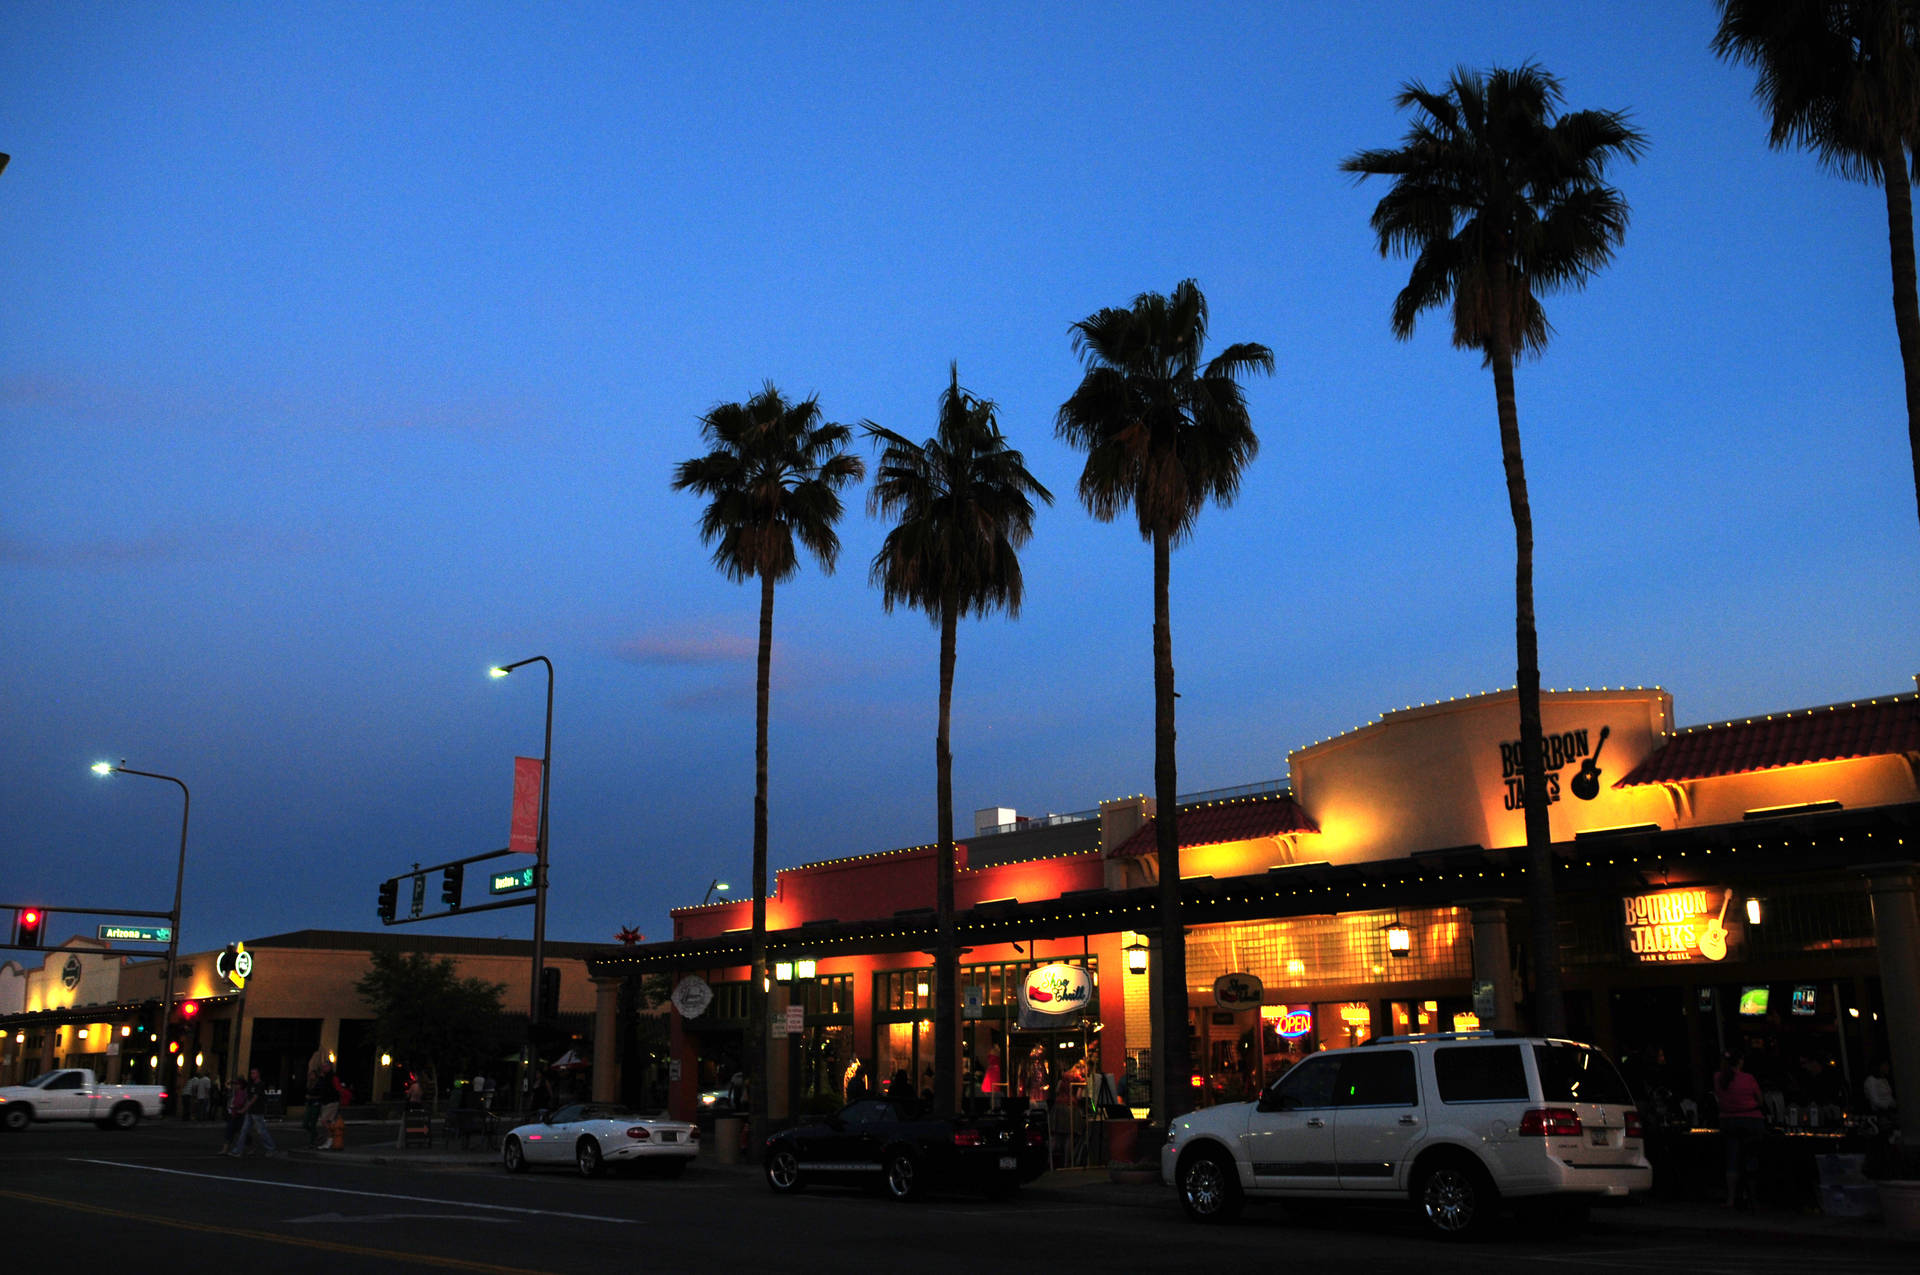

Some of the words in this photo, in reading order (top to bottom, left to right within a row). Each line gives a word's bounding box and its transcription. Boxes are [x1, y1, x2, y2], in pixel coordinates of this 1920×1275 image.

[1500, 729, 1588, 777] BORBON
[1624, 890, 1708, 926] BOURBON
[106, 928, 140, 939] Arizona
[1640, 954, 1657, 962] BAR
[1666, 952, 1691, 961] GRILL
[1041, 972, 1070, 990] Shoe
[1279, 1015, 1311, 1033] OPEN
